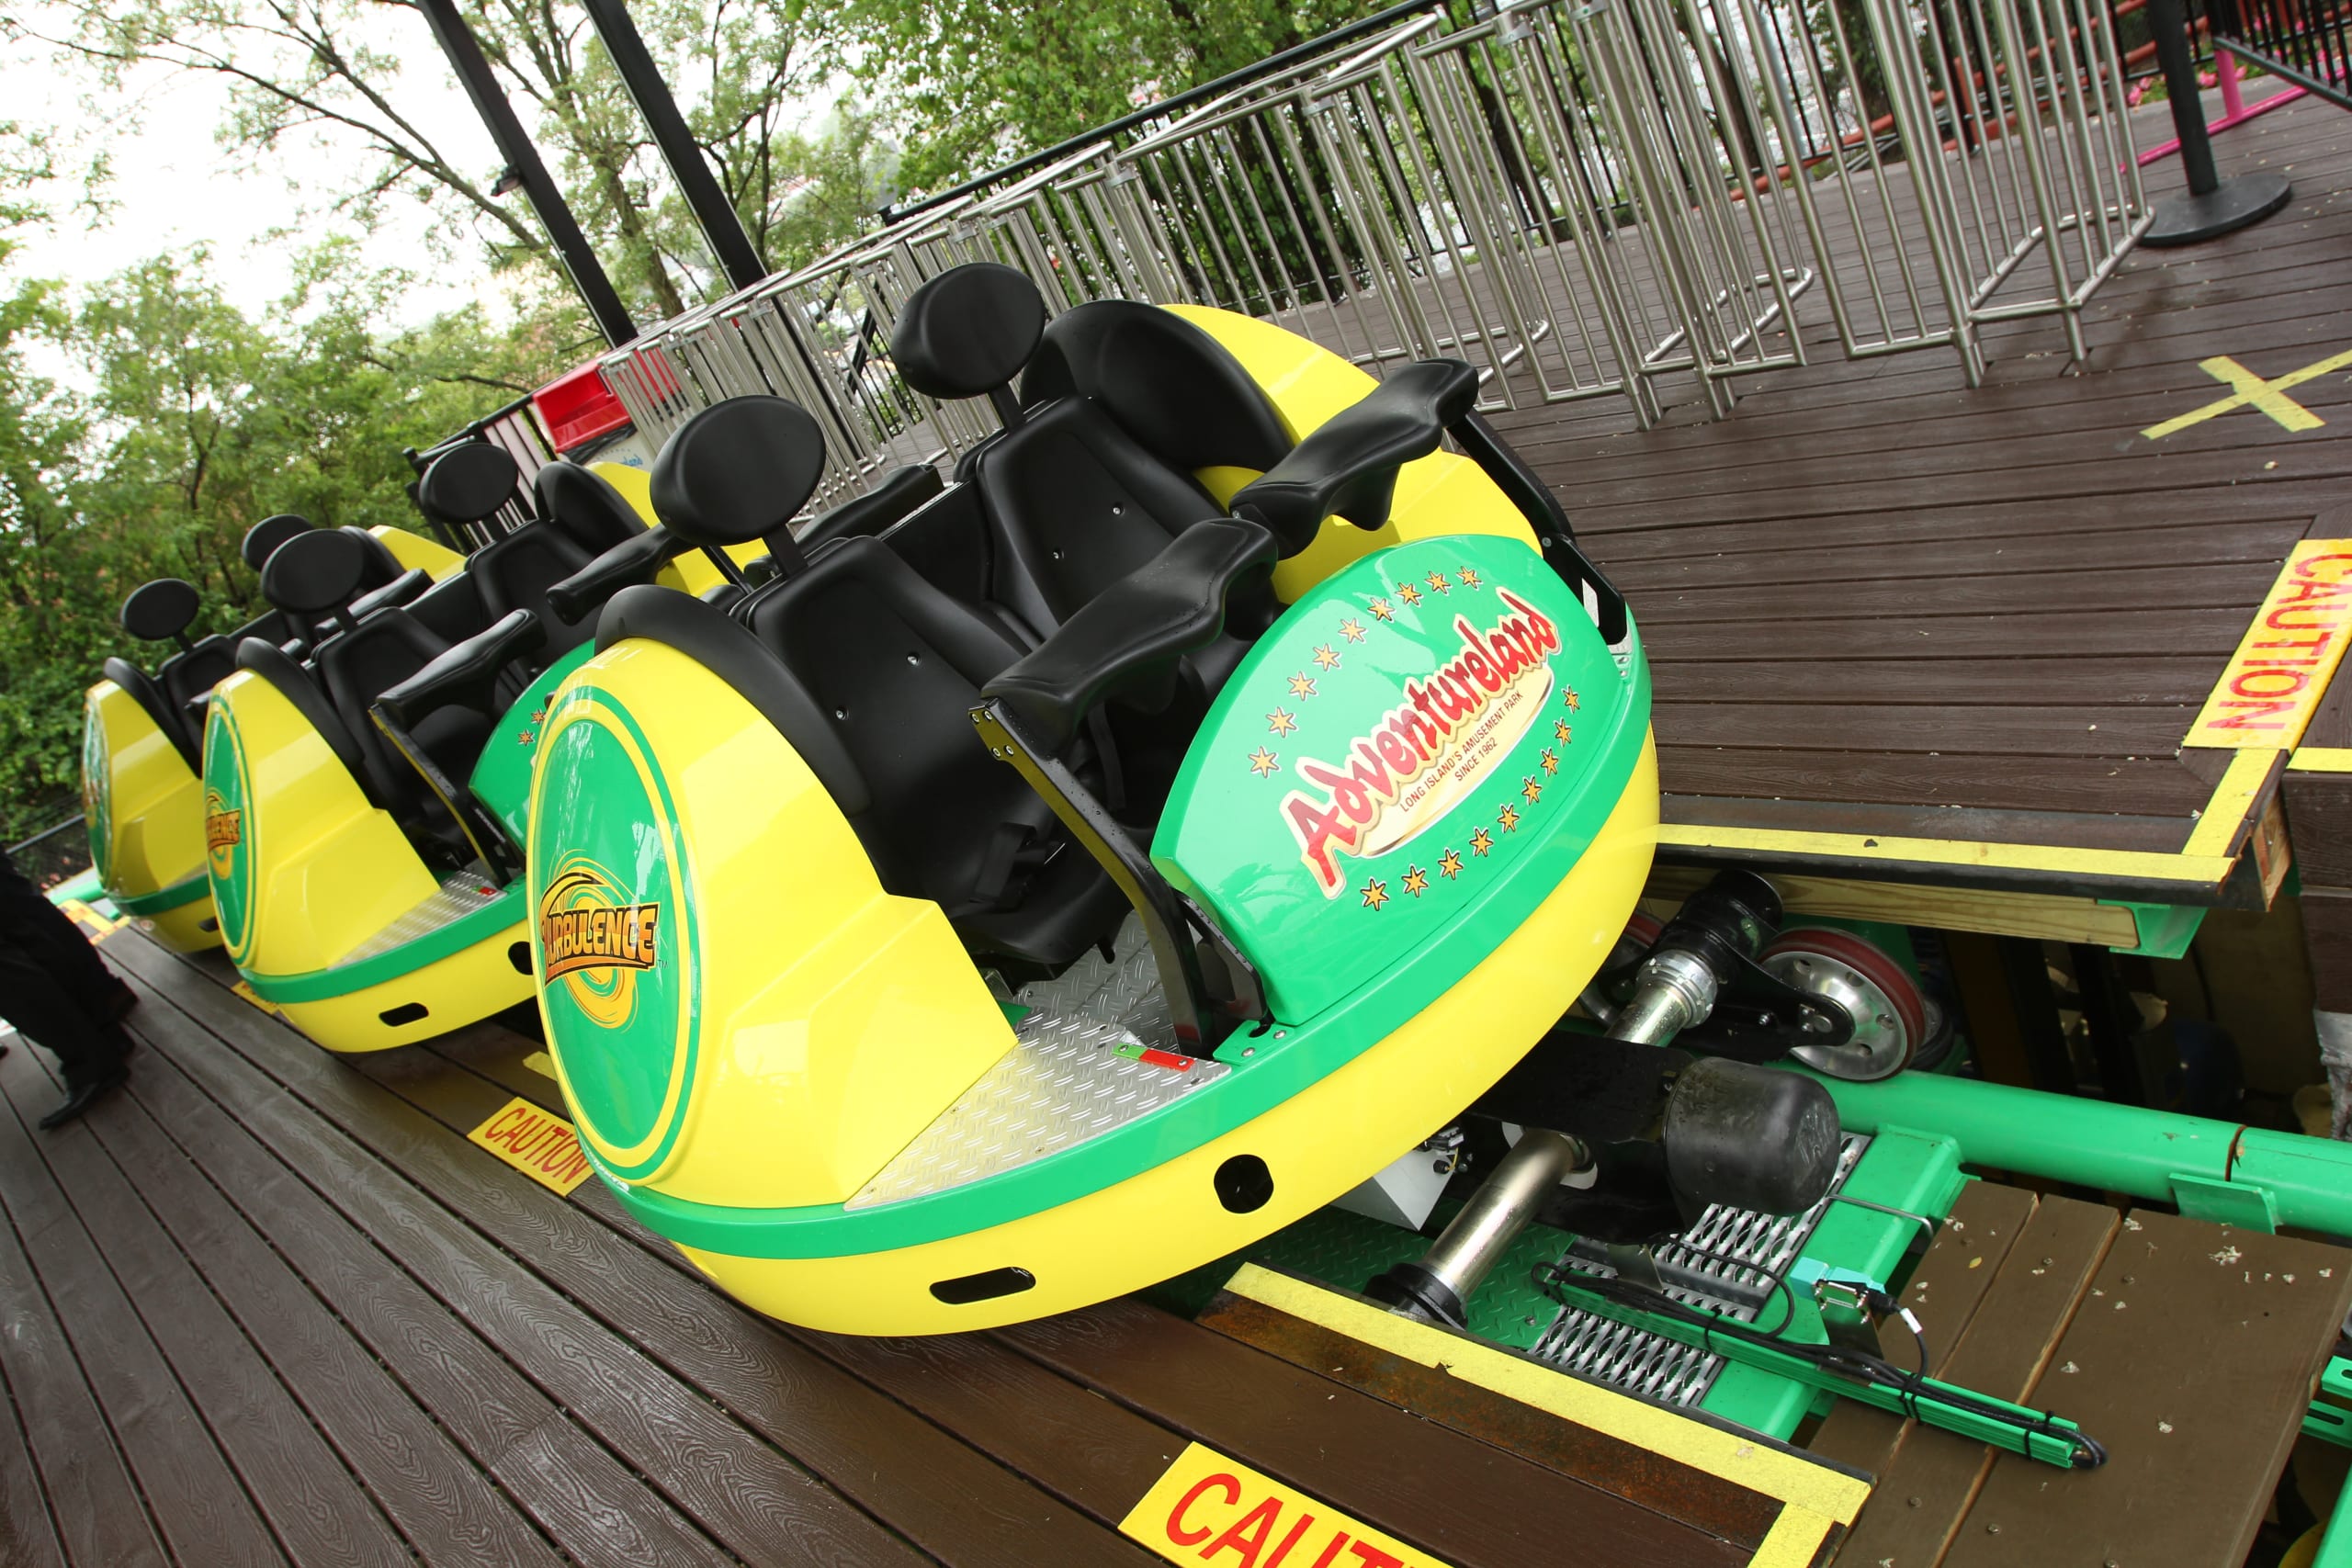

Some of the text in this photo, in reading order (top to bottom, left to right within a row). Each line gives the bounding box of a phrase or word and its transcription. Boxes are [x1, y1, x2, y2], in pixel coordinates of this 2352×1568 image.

[2206, 553, 2352, 728] CAUTION
[1399, 691, 1523, 812] LONG ISLAND'S AMUSEMENT PARK
[1454, 737, 1498, 781] SINCE 1962
[539, 872, 661, 974] TURBULENCE
[484, 1107, 590, 1184] CAUTION
